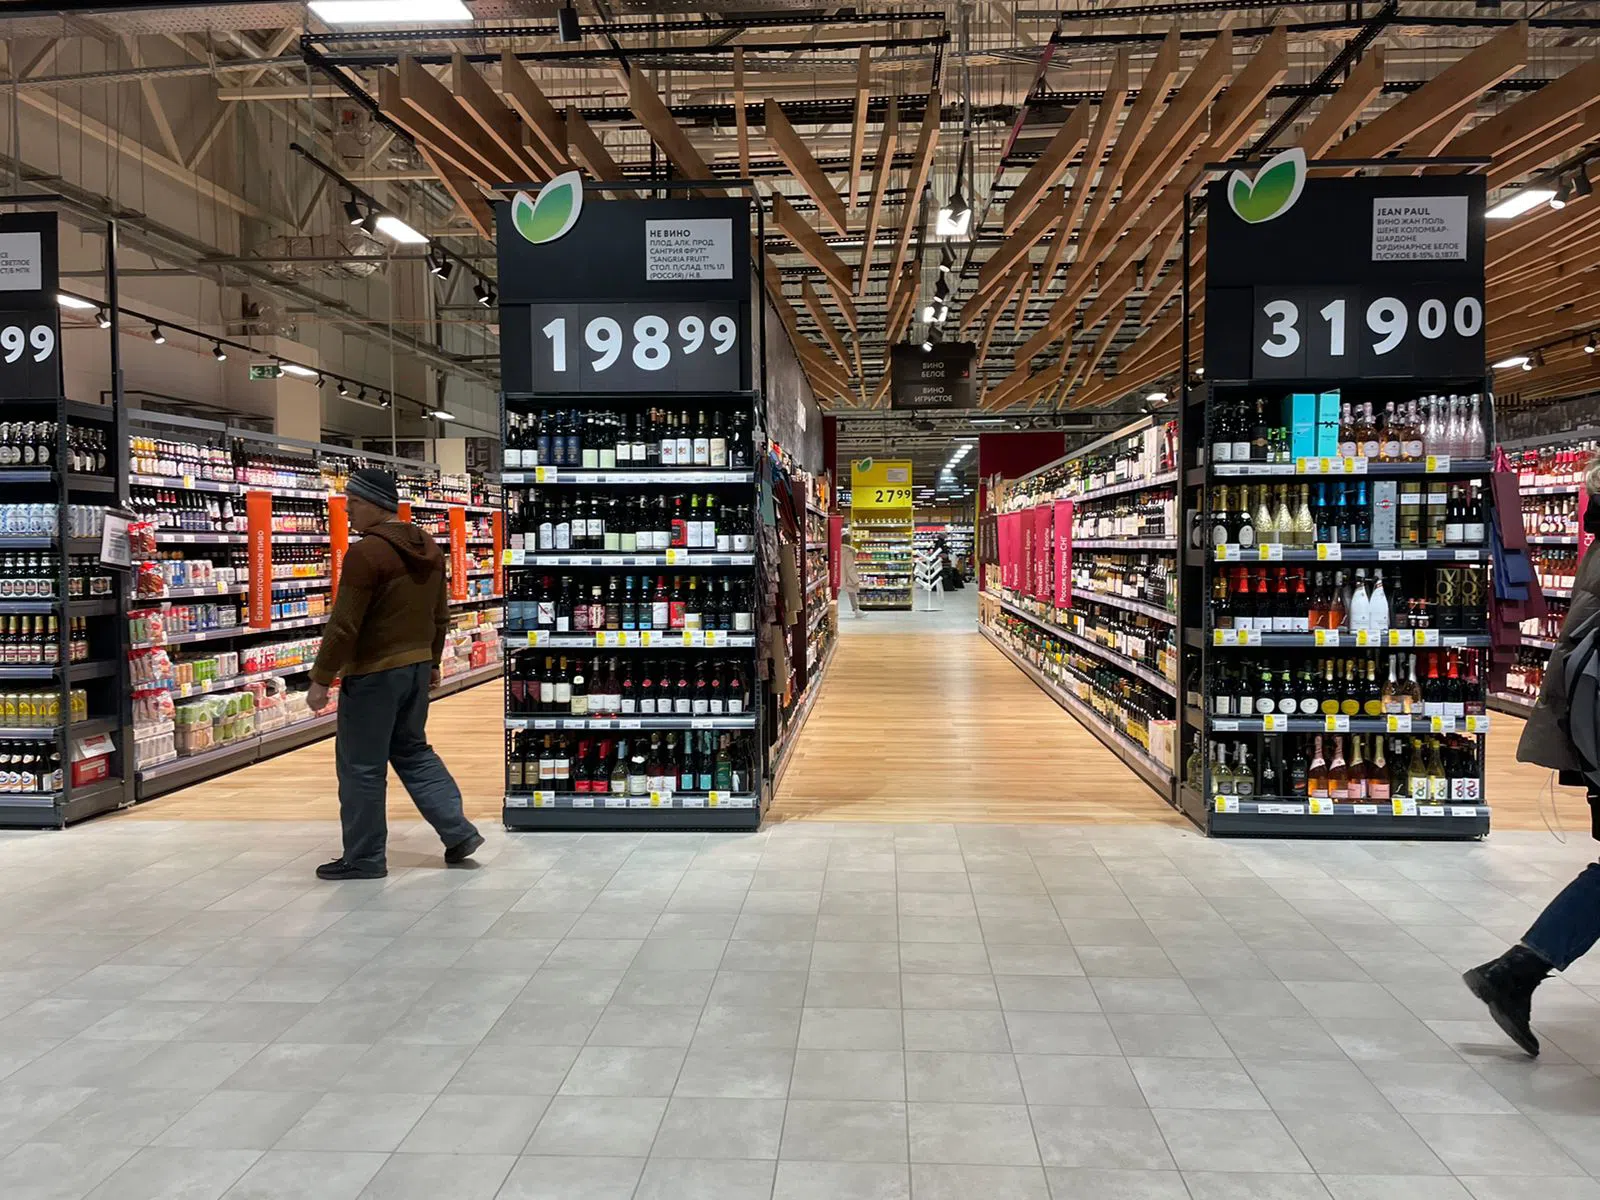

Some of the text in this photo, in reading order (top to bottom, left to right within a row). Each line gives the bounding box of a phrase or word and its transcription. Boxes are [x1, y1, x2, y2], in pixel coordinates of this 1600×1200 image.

[1377, 208, 1430, 216] JEAN PAUL
[255, 553, 264, 622] Безалкогольное
